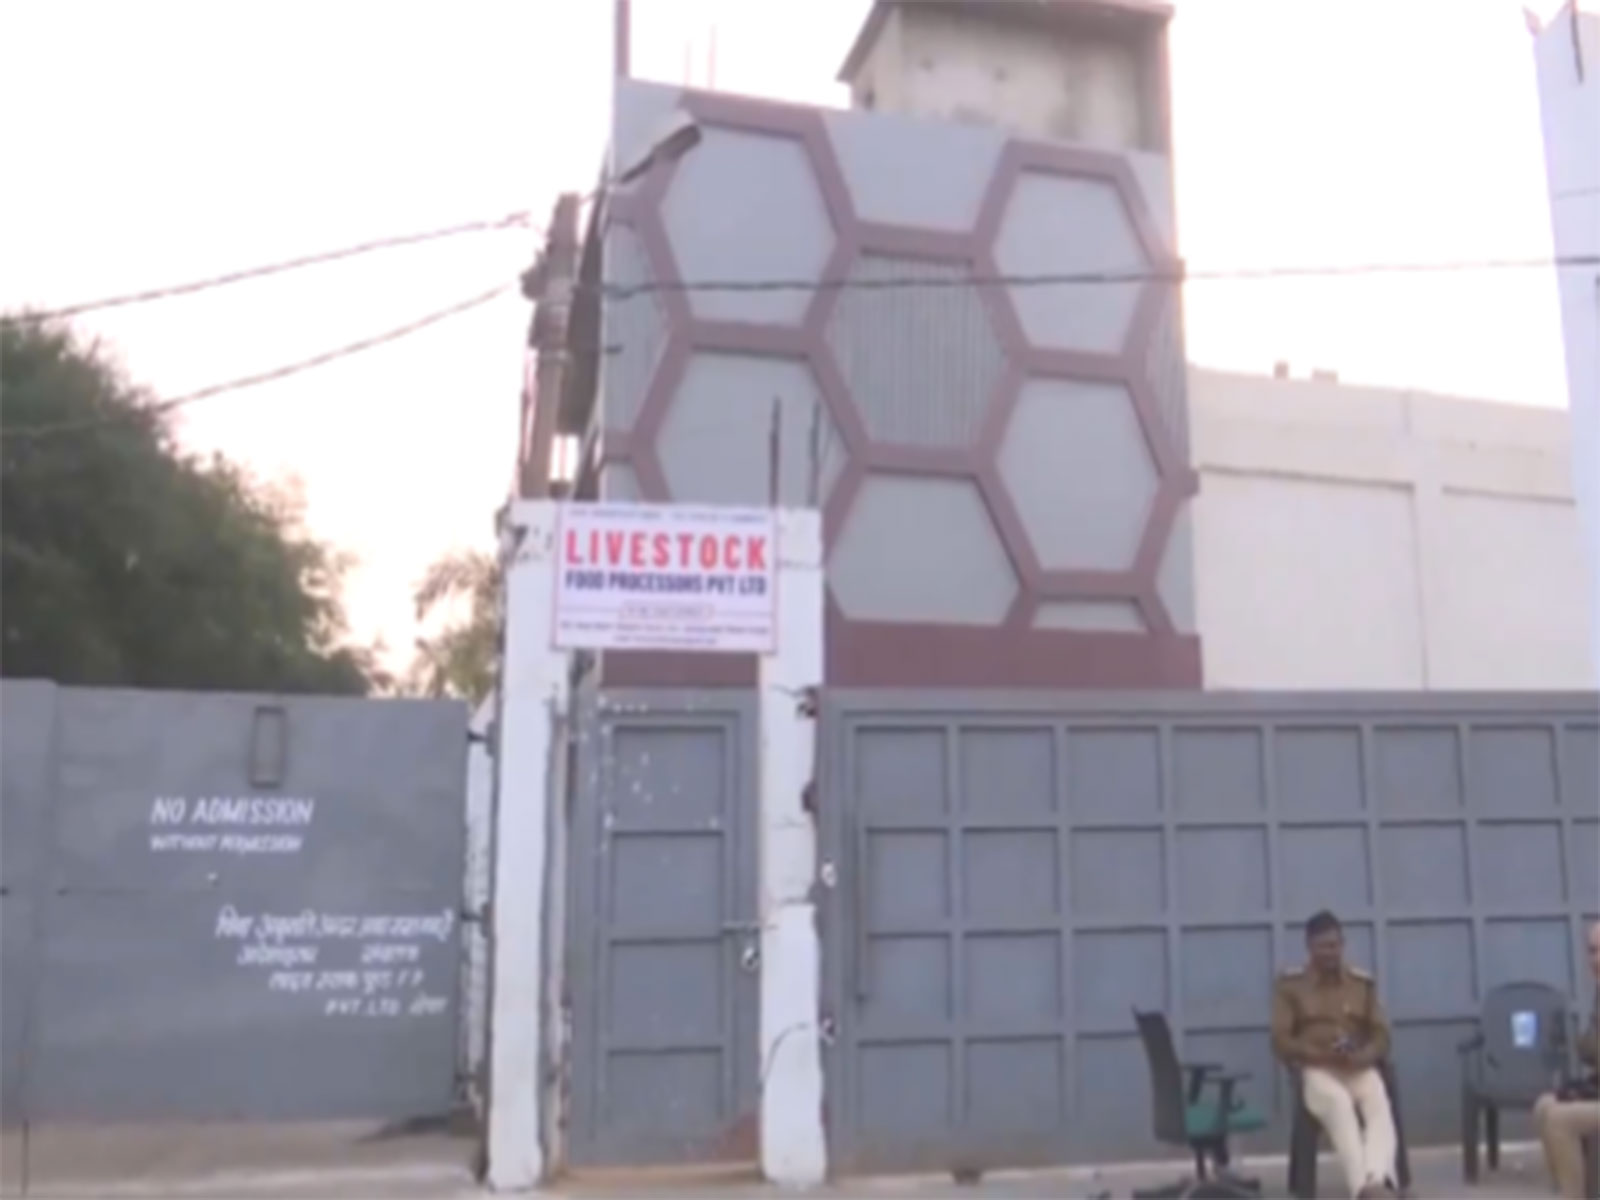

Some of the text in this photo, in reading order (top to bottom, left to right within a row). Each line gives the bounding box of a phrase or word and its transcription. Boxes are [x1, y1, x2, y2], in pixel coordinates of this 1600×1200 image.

[566, 529, 767, 570] LIVESTOCK
[565, 571, 605, 592] FOOD
[707, 575, 735, 595] PVT
[738, 576, 767, 596] LTD
[150, 797, 314, 825] NO ADMISSION
[149, 834, 217, 852] WITHOUT
